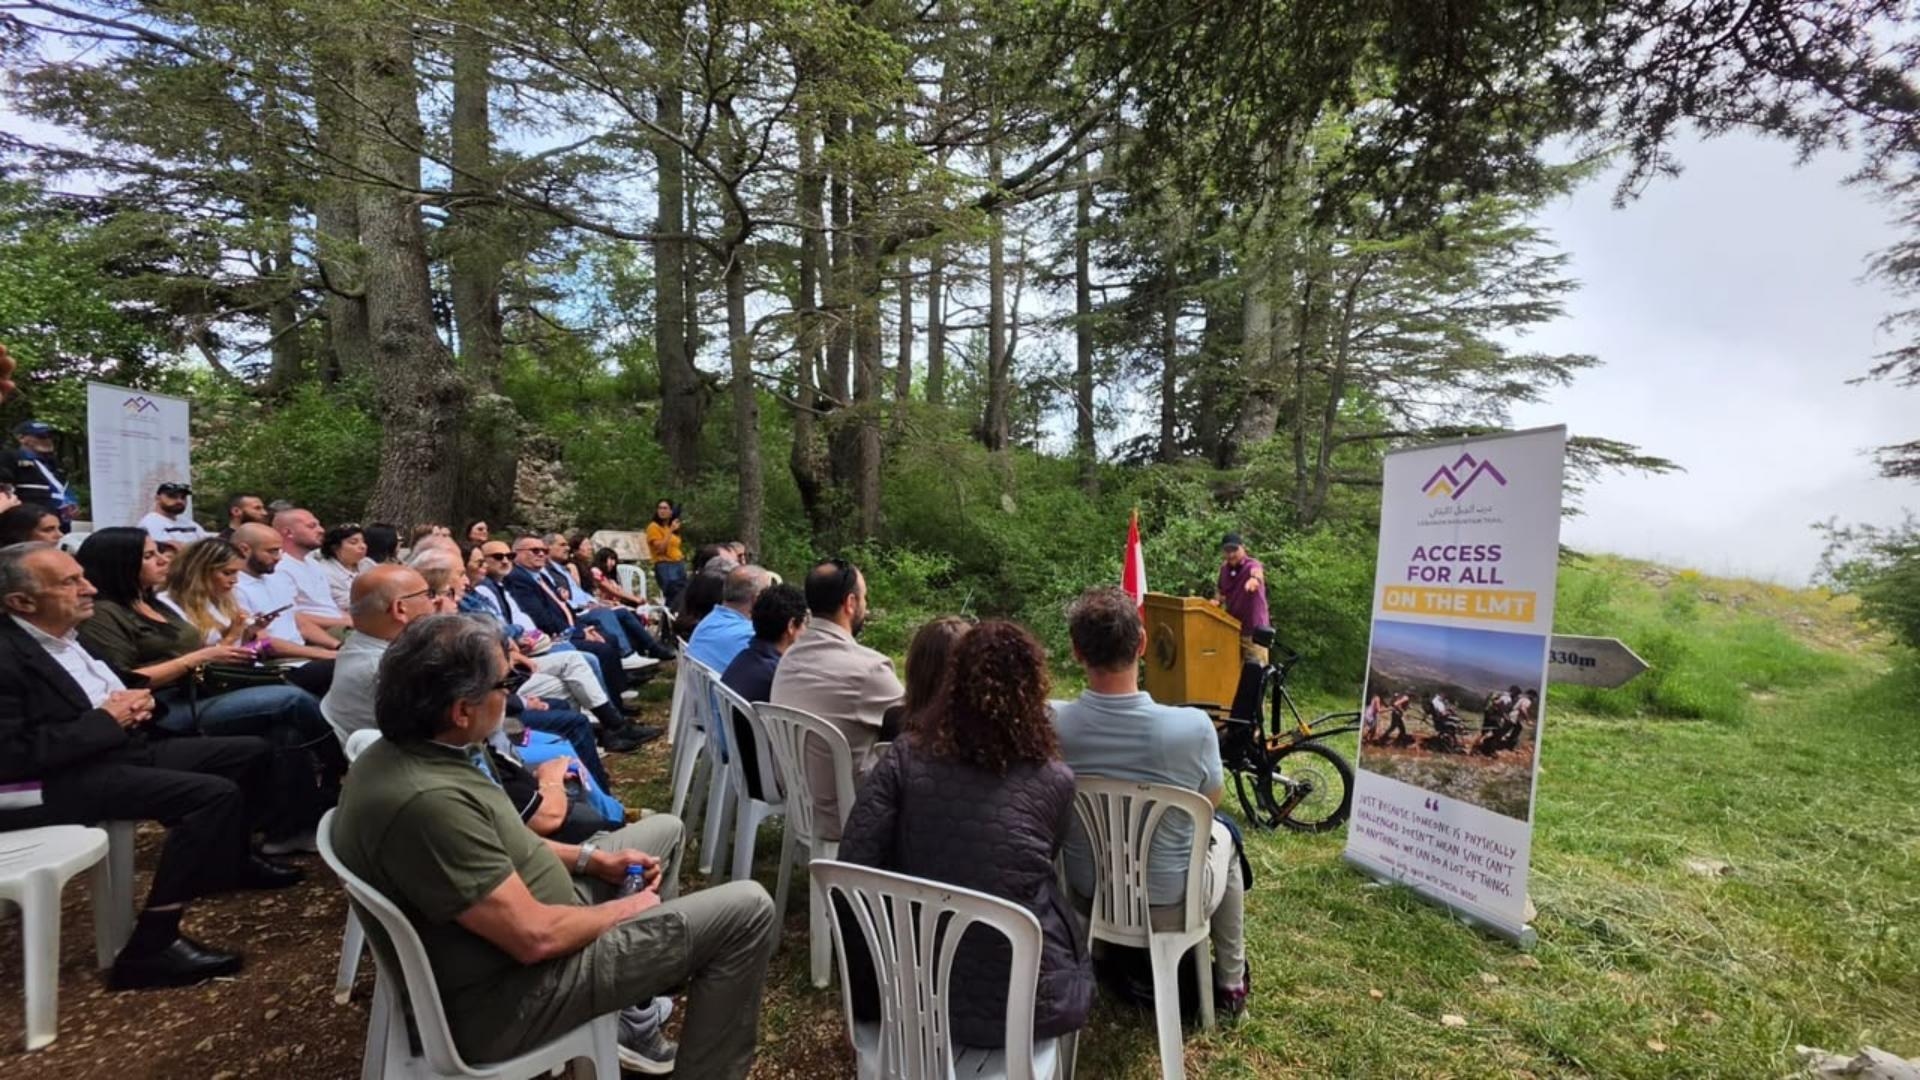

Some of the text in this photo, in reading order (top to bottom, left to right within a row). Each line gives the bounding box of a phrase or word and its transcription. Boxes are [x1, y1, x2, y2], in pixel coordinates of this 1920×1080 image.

[1407, 565, 1504, 584] FOR ALL
[1411, 544, 1502, 562] ACCESS
[1386, 590, 1529, 616] ON THE LMT
[1357, 808, 1517, 878] CHALLENGED DOESN'T MEAN S/HE CAN'T
[1359, 794, 1517, 861] JUST BECAUSE SOMEONE IS PHYSICALLY
[1356, 824, 1365, 834] DO
[1403, 844, 1414, 857] WE
[1415, 847, 1430, 862] CAN
[1431, 854, 1442, 866] DO
[1449, 861, 1467, 877] LOT
[1465, 869, 1480, 883] OF
[1480, 872, 1514, 898] THINGS.
